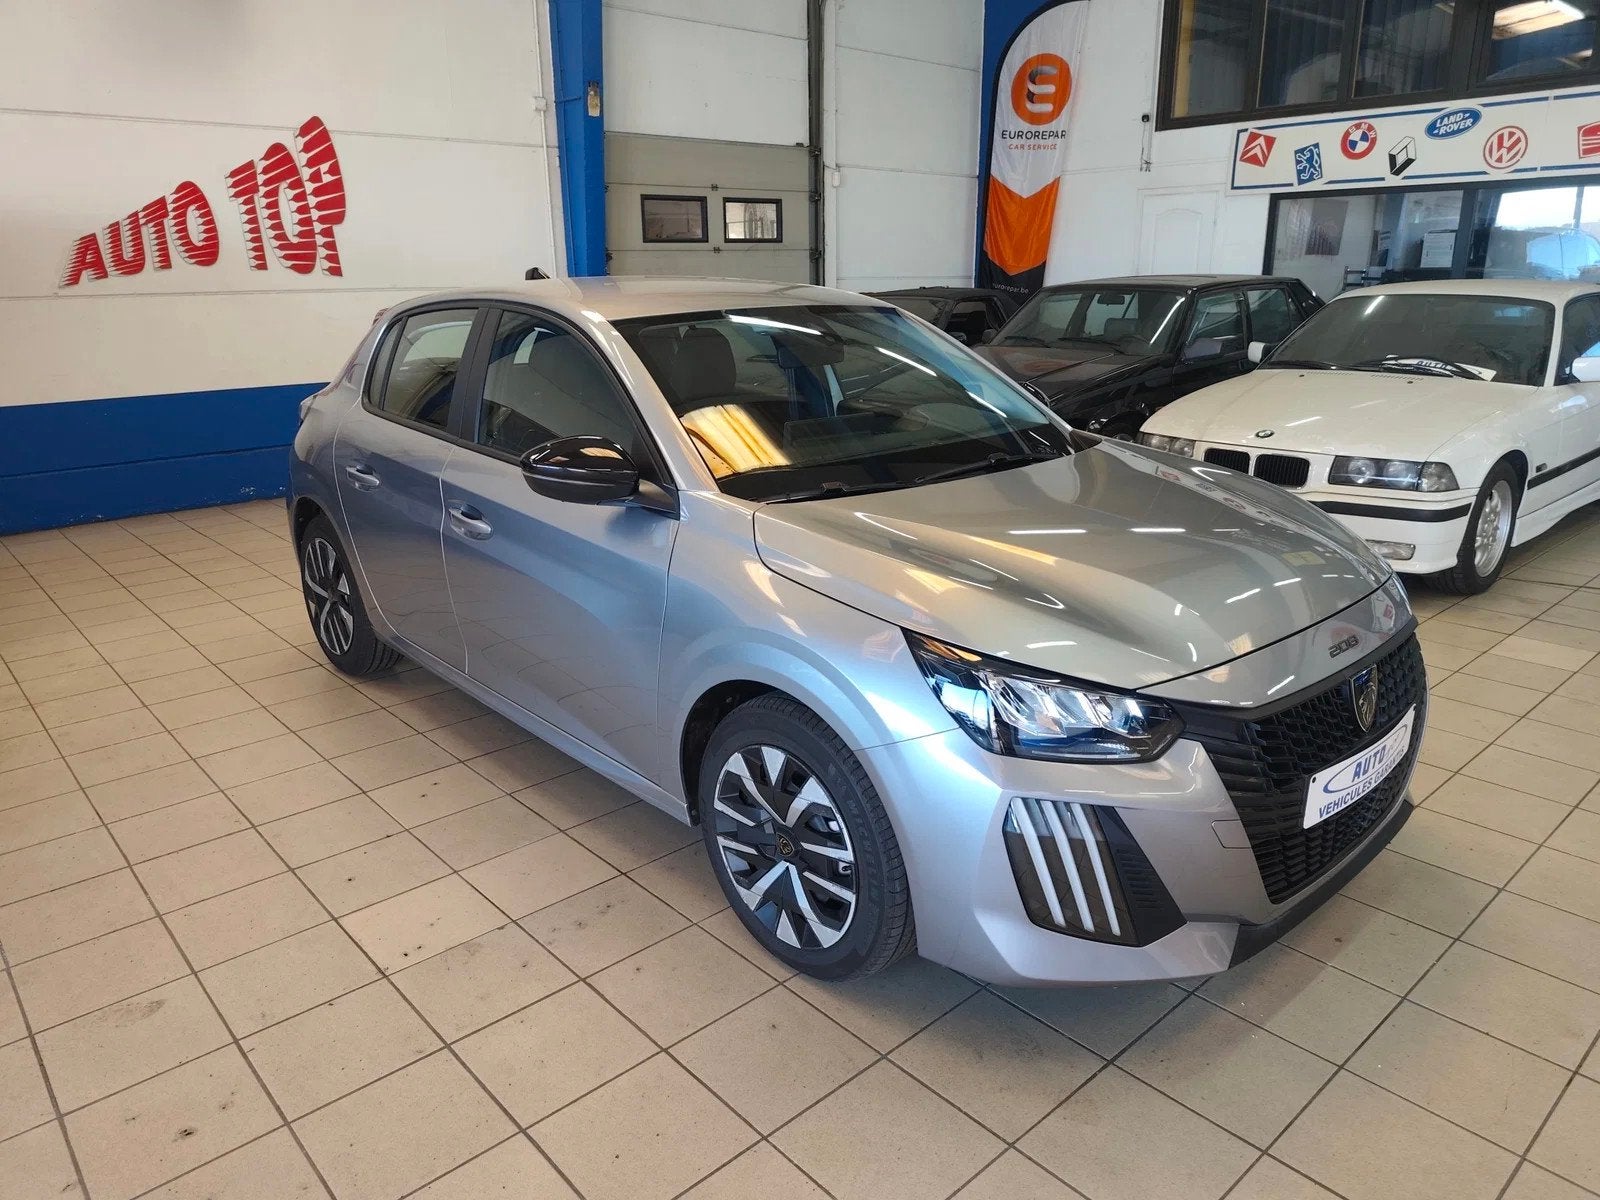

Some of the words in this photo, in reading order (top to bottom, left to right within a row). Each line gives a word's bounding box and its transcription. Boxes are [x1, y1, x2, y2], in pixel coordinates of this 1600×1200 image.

[1436, 112, 1465, 128] LAND
[1438, 118, 1474, 136] ROVER
[1001, 129, 1067, 140] EUROREPAR
[1008, 143, 1025, 151] CAR
[1027, 143, 1058, 151] SERVICE
[58, 180, 220, 288] AUTO
[223, 115, 347, 278] TOP
[1328, 635, 1360, 658] 208
[1352, 744, 1387, 783] AUTO
[1318, 775, 1374, 818] VEHICULES
